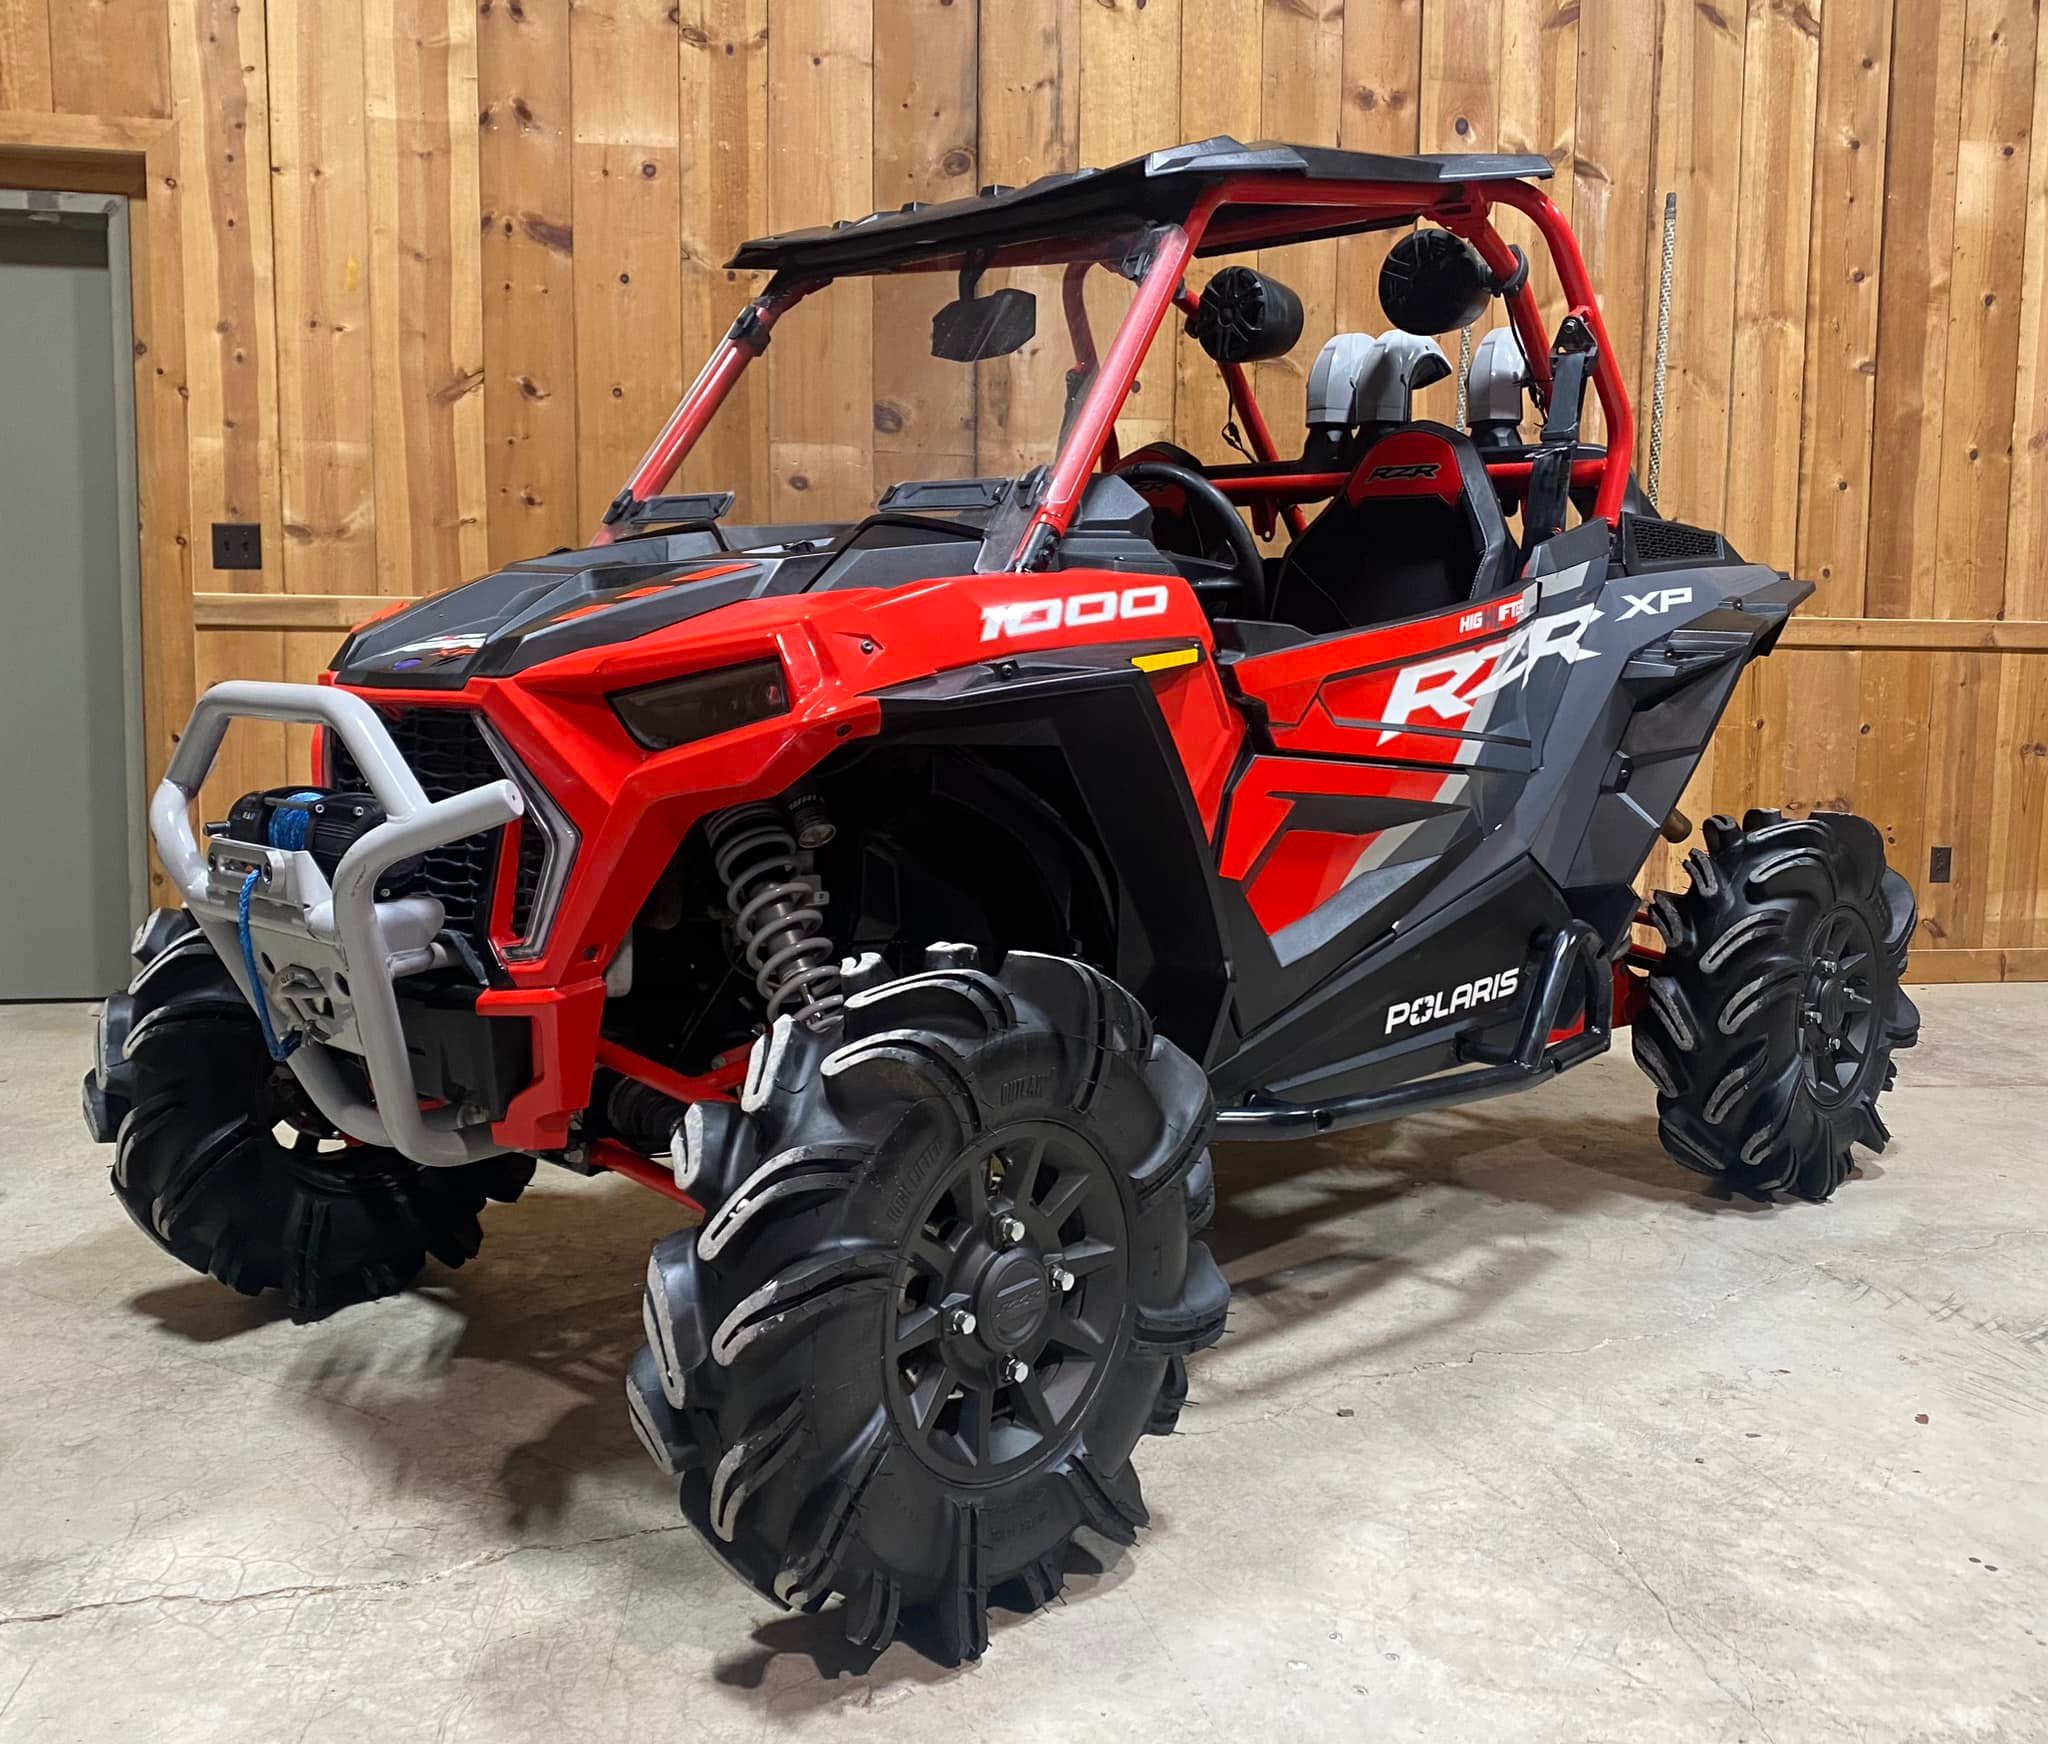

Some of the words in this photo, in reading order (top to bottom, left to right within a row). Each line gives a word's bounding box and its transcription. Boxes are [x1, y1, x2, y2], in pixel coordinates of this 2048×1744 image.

[1364, 463, 1442, 484] RZR
[980, 585, 1168, 642] 1000
[1614, 587, 1693, 622] XP
[1377, 602, 1606, 747] RZR
[1385, 967, 1520, 1035] POLARIS
